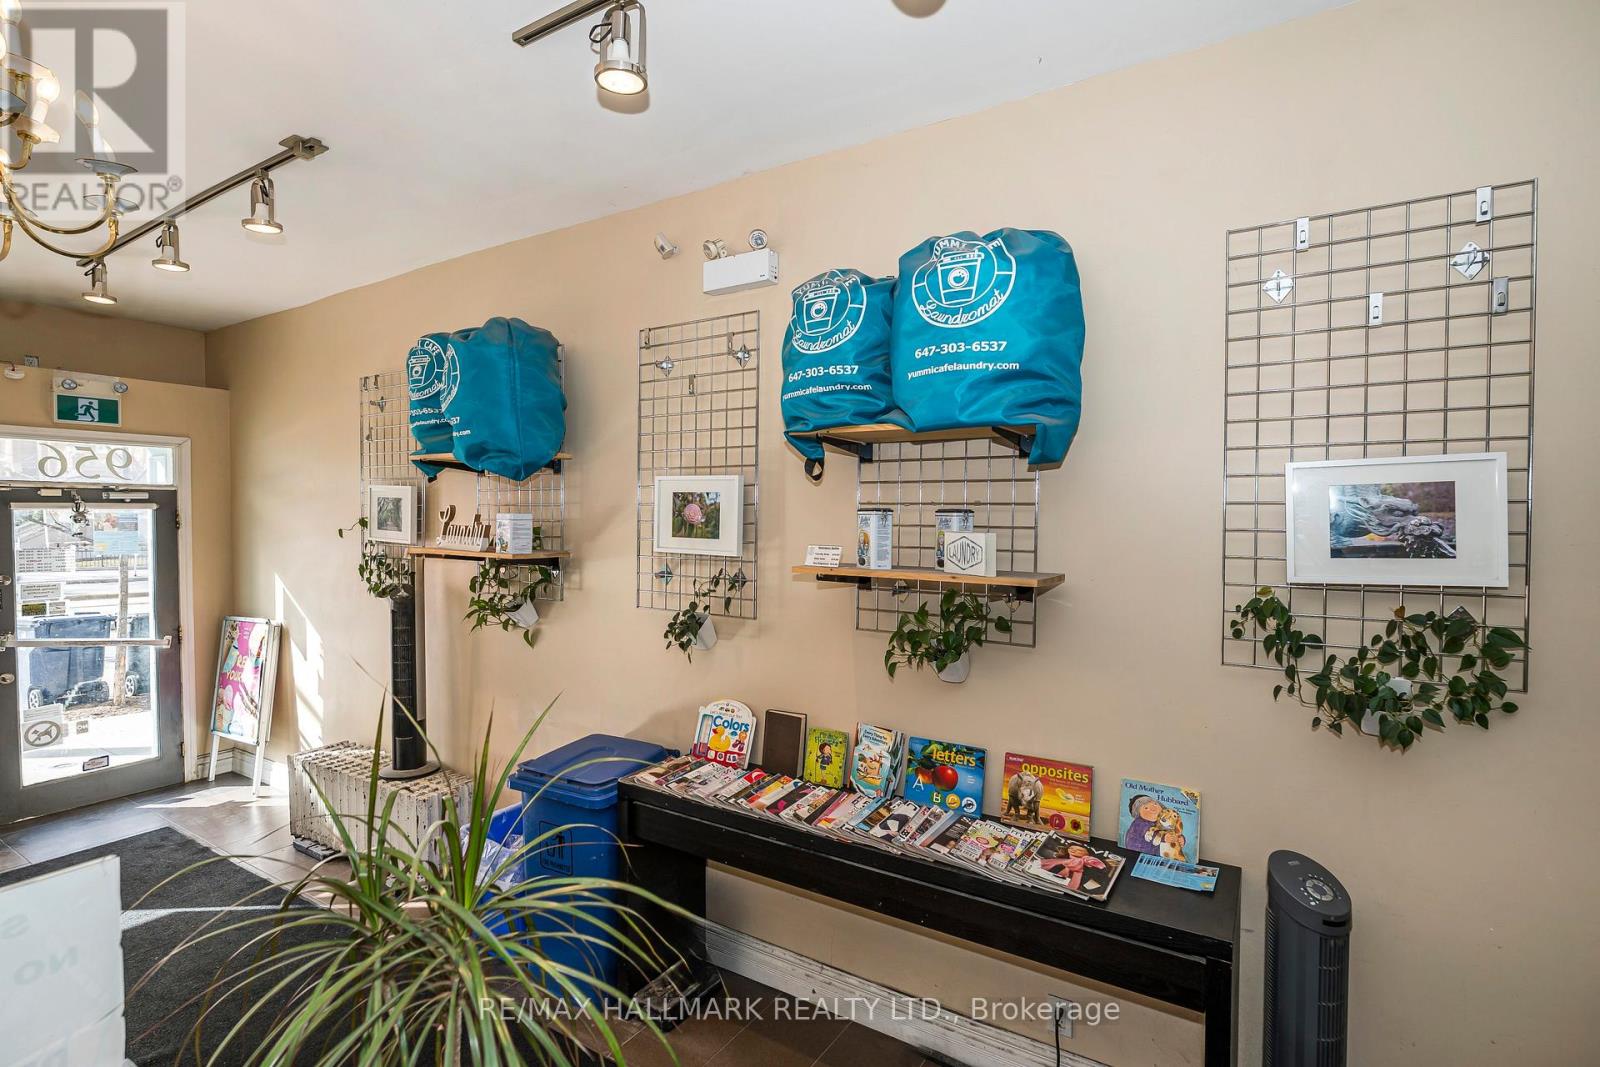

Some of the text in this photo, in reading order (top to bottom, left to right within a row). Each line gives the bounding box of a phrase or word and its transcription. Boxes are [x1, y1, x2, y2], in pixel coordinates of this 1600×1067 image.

[919, 289, 1003, 325] Laundromat
[792, 319, 856, 351] Laundromat
[914, 340, 1008, 359] 647-303-6537
[788, 365, 859, 382] 647-303-6537
[907, 361, 1020, 380] yummicafelaundry.com
[948, 540, 981, 565] LAUNDRY
[713, 715, 750, 732] Colors
[932, 748, 976, 767] letters
[912, 774, 924, 791] A
[1021, 763, 1089, 783] opposites
[1125, 782, 1165, 794] Old Mother
[1156, 794, 1190, 806] Hubbard
